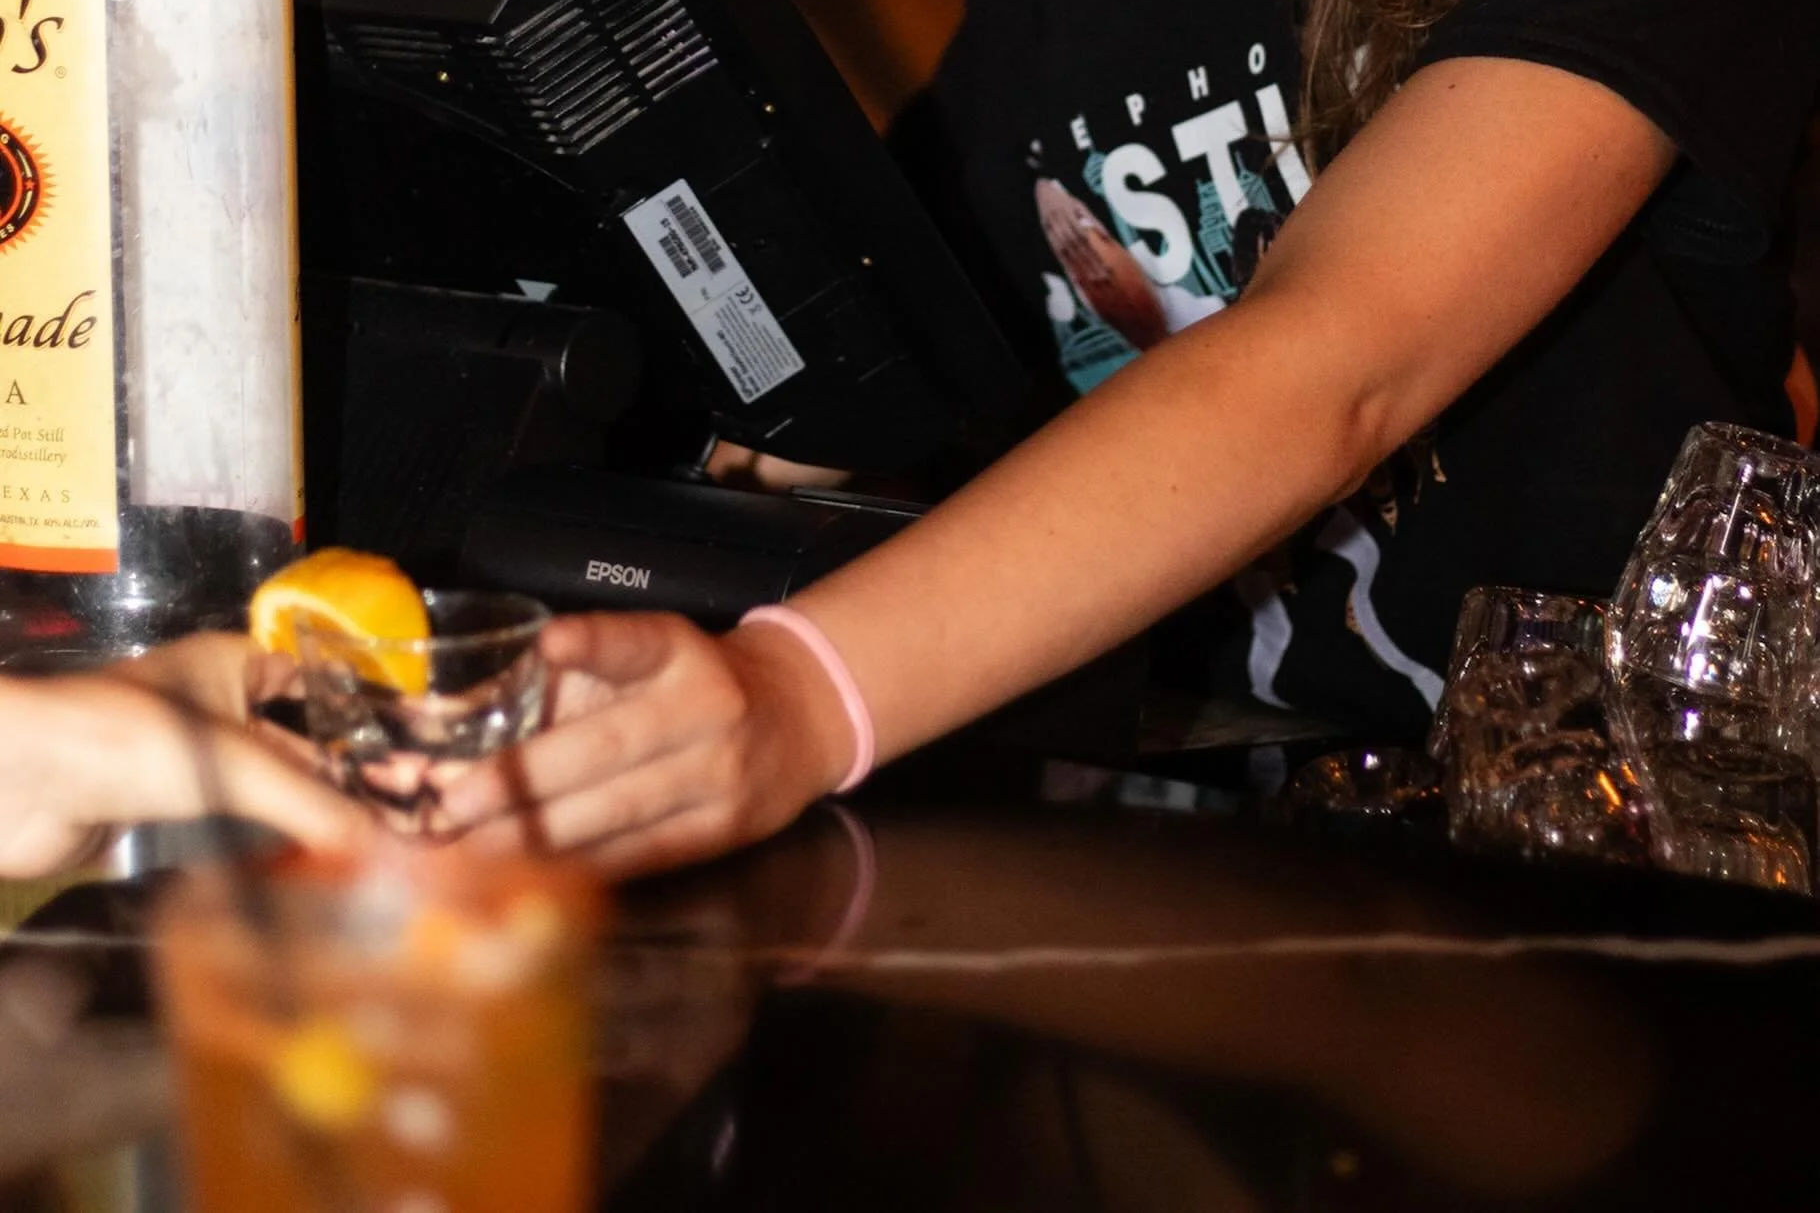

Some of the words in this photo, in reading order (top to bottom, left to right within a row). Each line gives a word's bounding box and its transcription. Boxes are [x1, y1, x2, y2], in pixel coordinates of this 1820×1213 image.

[0, 289, 98, 349] ade
[13, 427, 32, 442] Pot
[36, 426, 65, 443] Still
[585, 560, 651, 589] EPSON
